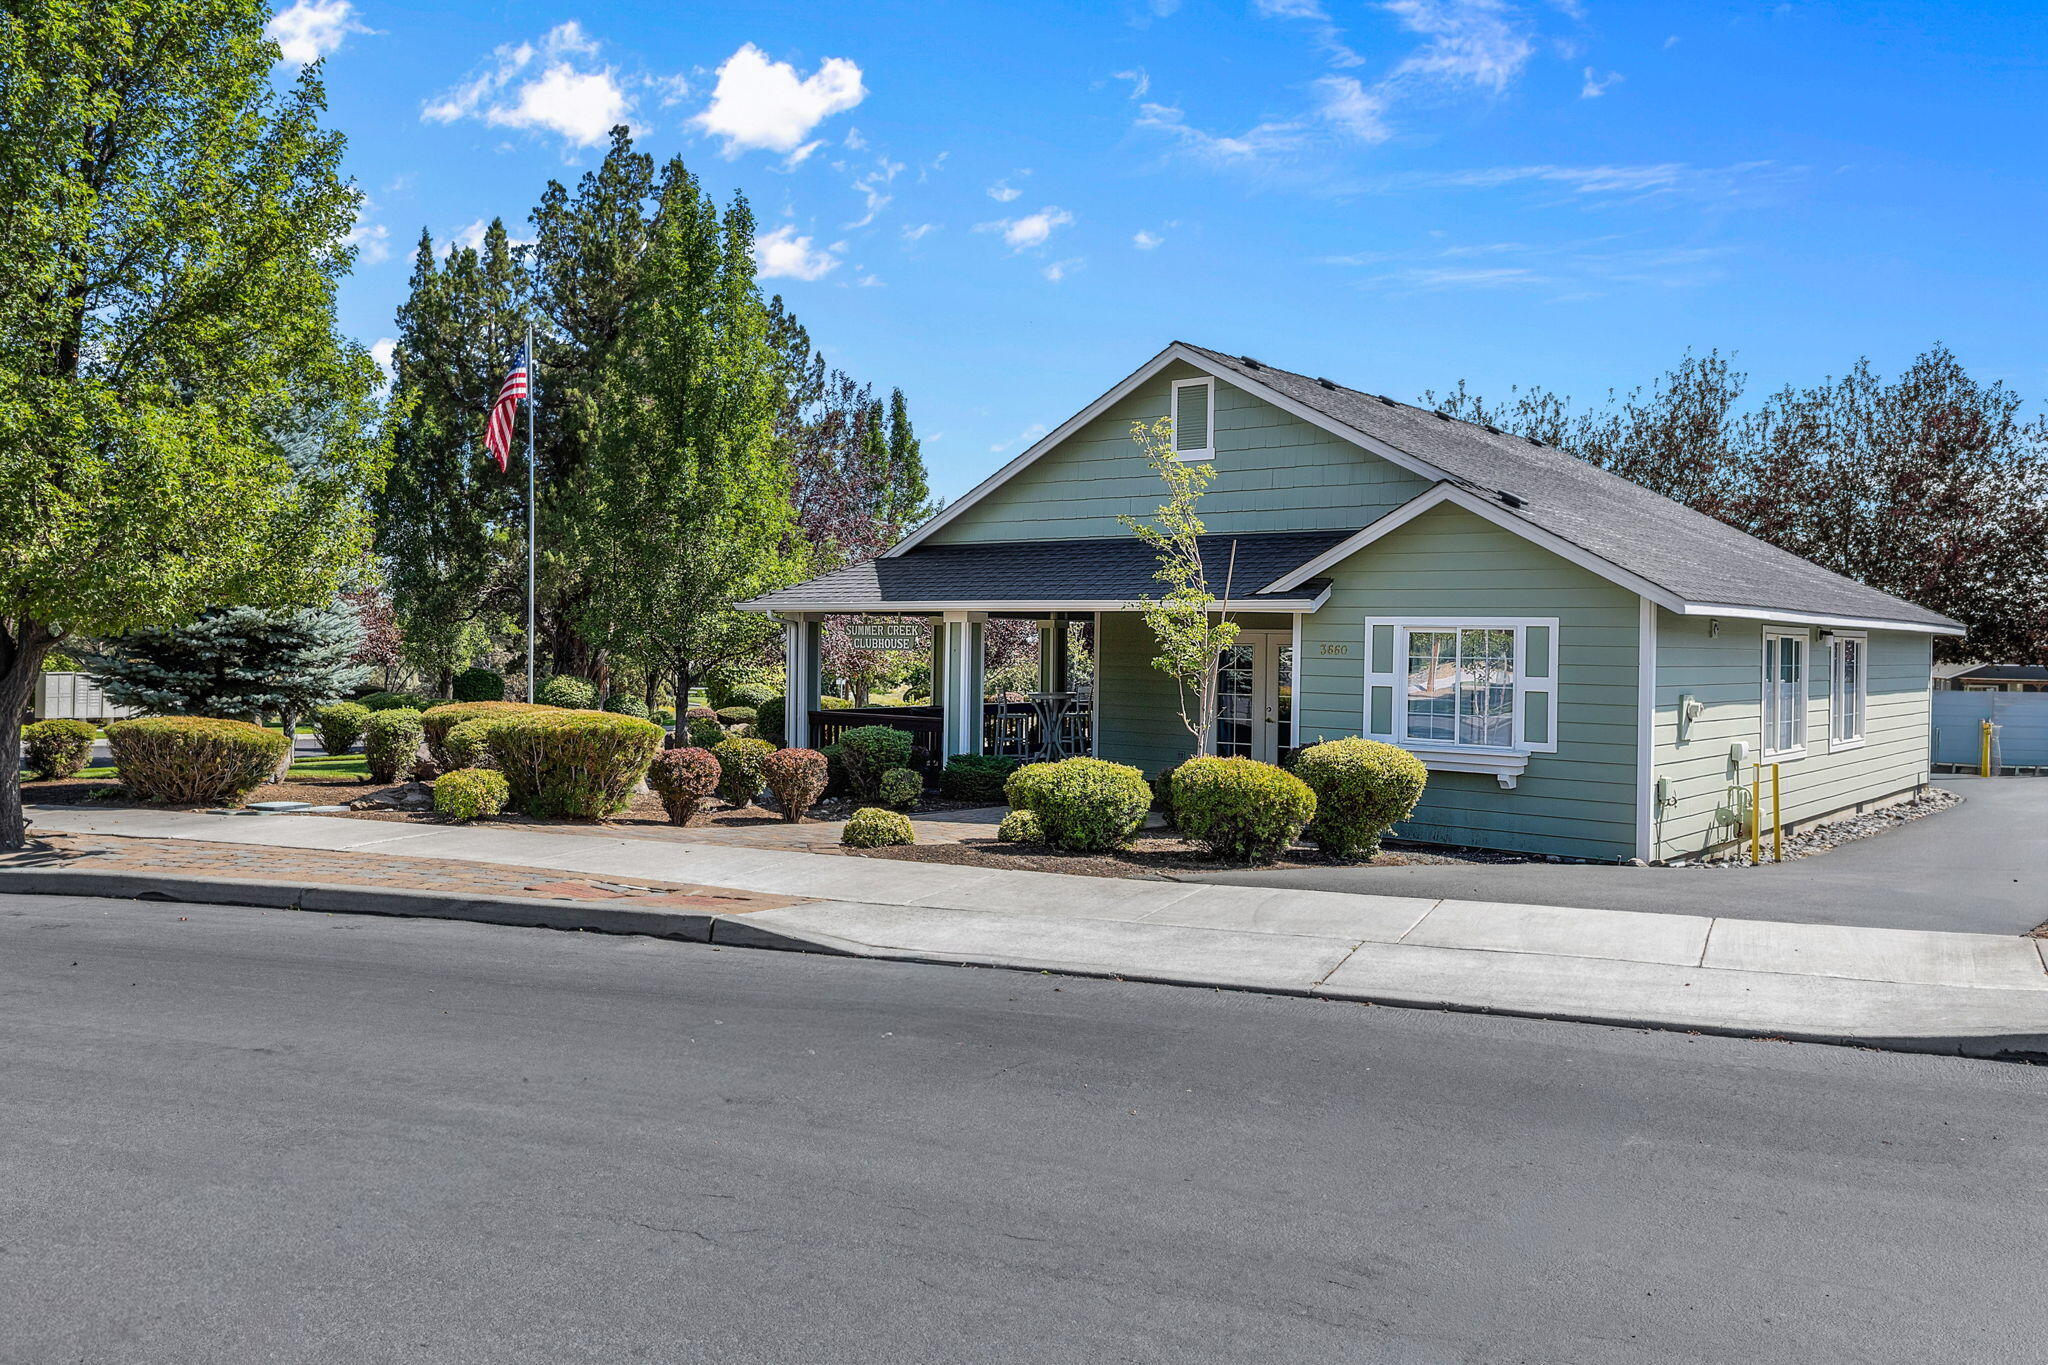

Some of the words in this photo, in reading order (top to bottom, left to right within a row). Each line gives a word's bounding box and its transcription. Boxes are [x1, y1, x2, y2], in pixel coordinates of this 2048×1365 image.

[846, 625, 883, 636] SUMMER
[887, 625, 918, 636] CREEK
[854, 638, 910, 649] CLUBHOUSE
